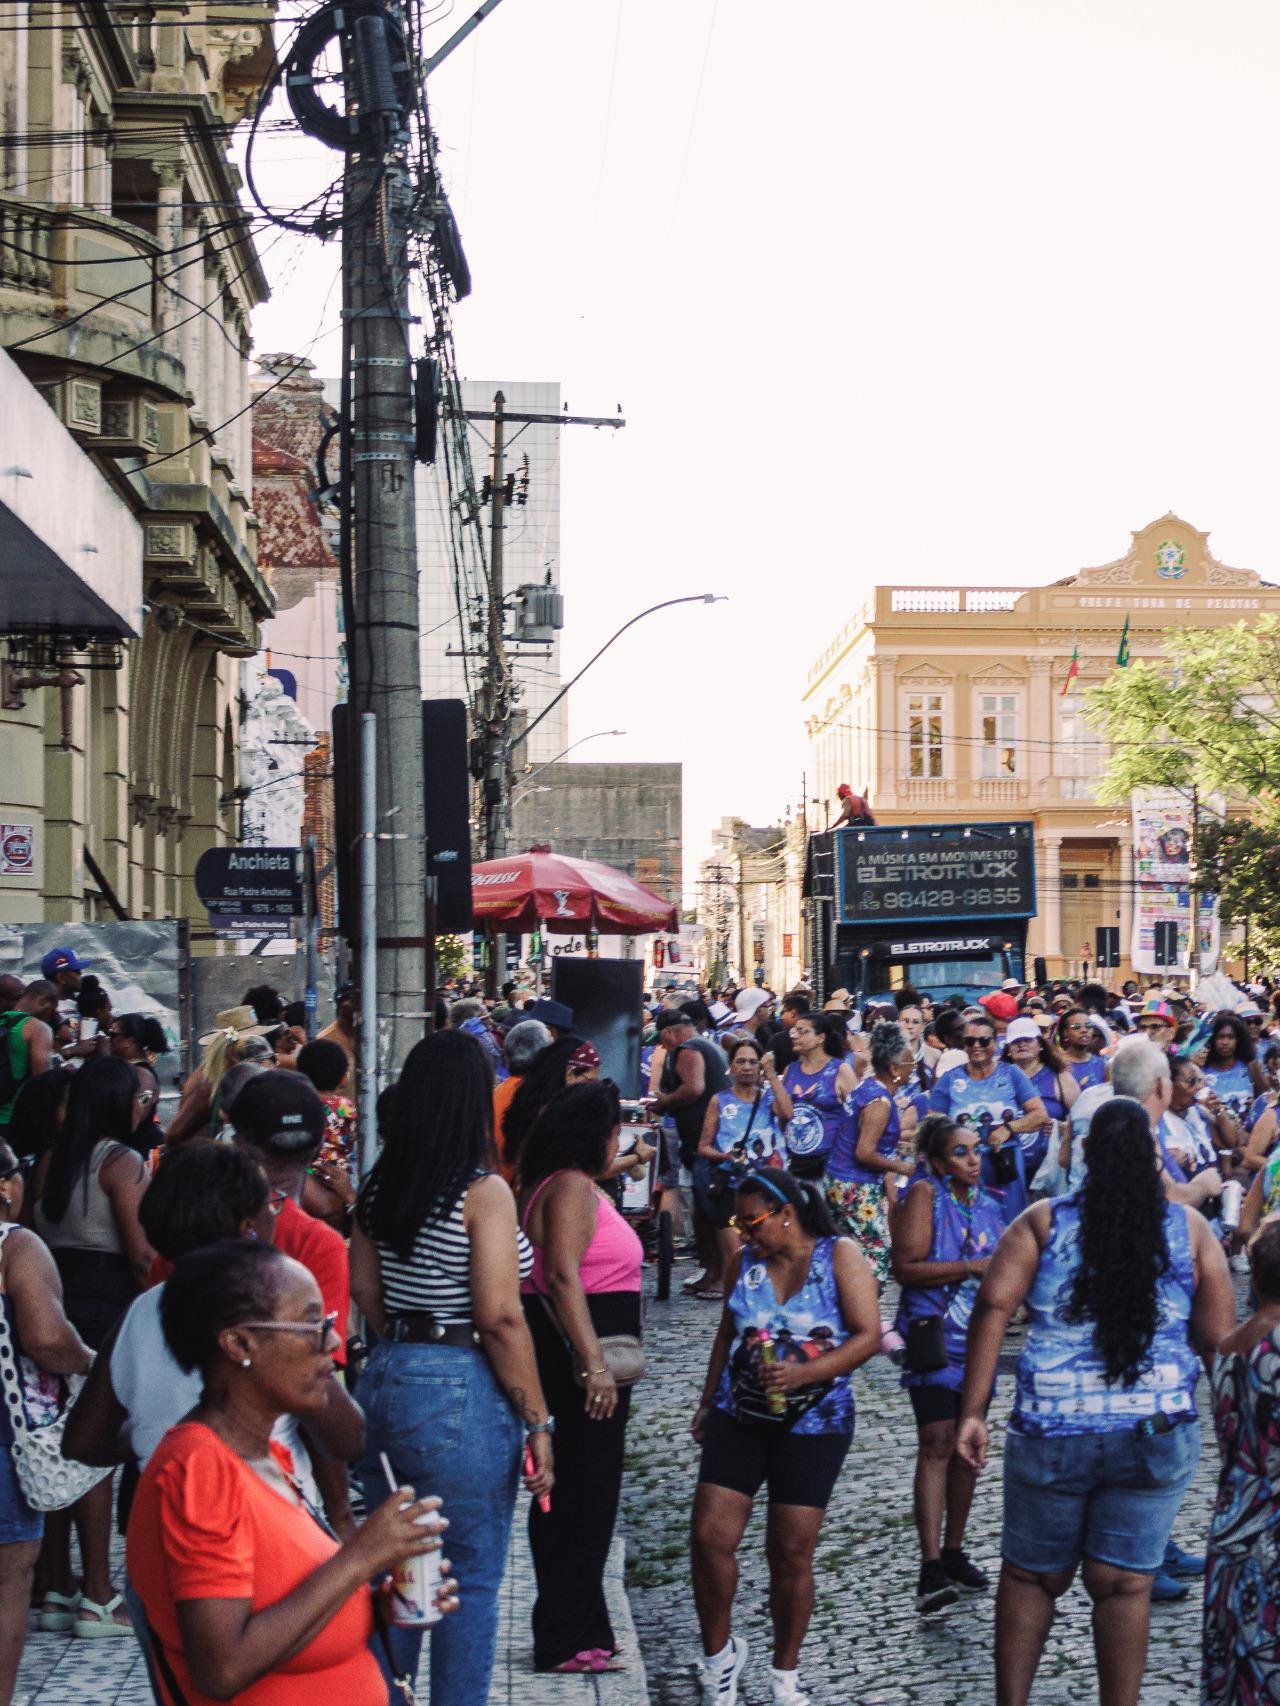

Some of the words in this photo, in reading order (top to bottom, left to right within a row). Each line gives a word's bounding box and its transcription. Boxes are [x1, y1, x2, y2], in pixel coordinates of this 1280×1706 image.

[1080, 597, 1165, 608] PREFETURA
[1207, 598, 1258, 609] PELOTAS
[228, 852, 291, 870] Anchieta
[856, 856, 865, 865] A
[868, 851, 917, 865] MÚSICA
[919, 853, 938, 863] EM
[940, 850, 1018, 862] MOVIMENTO
[857, 862, 1018, 883] ELETROTRUCK
[223, 887, 238, 896] Rua
[239, 887, 259, 896] Padre
[260, 887, 292, 896] Anchieta
[883, 887, 1021, 909] 98428-9855
[890, 938, 991, 955] ELETROTRUCK
